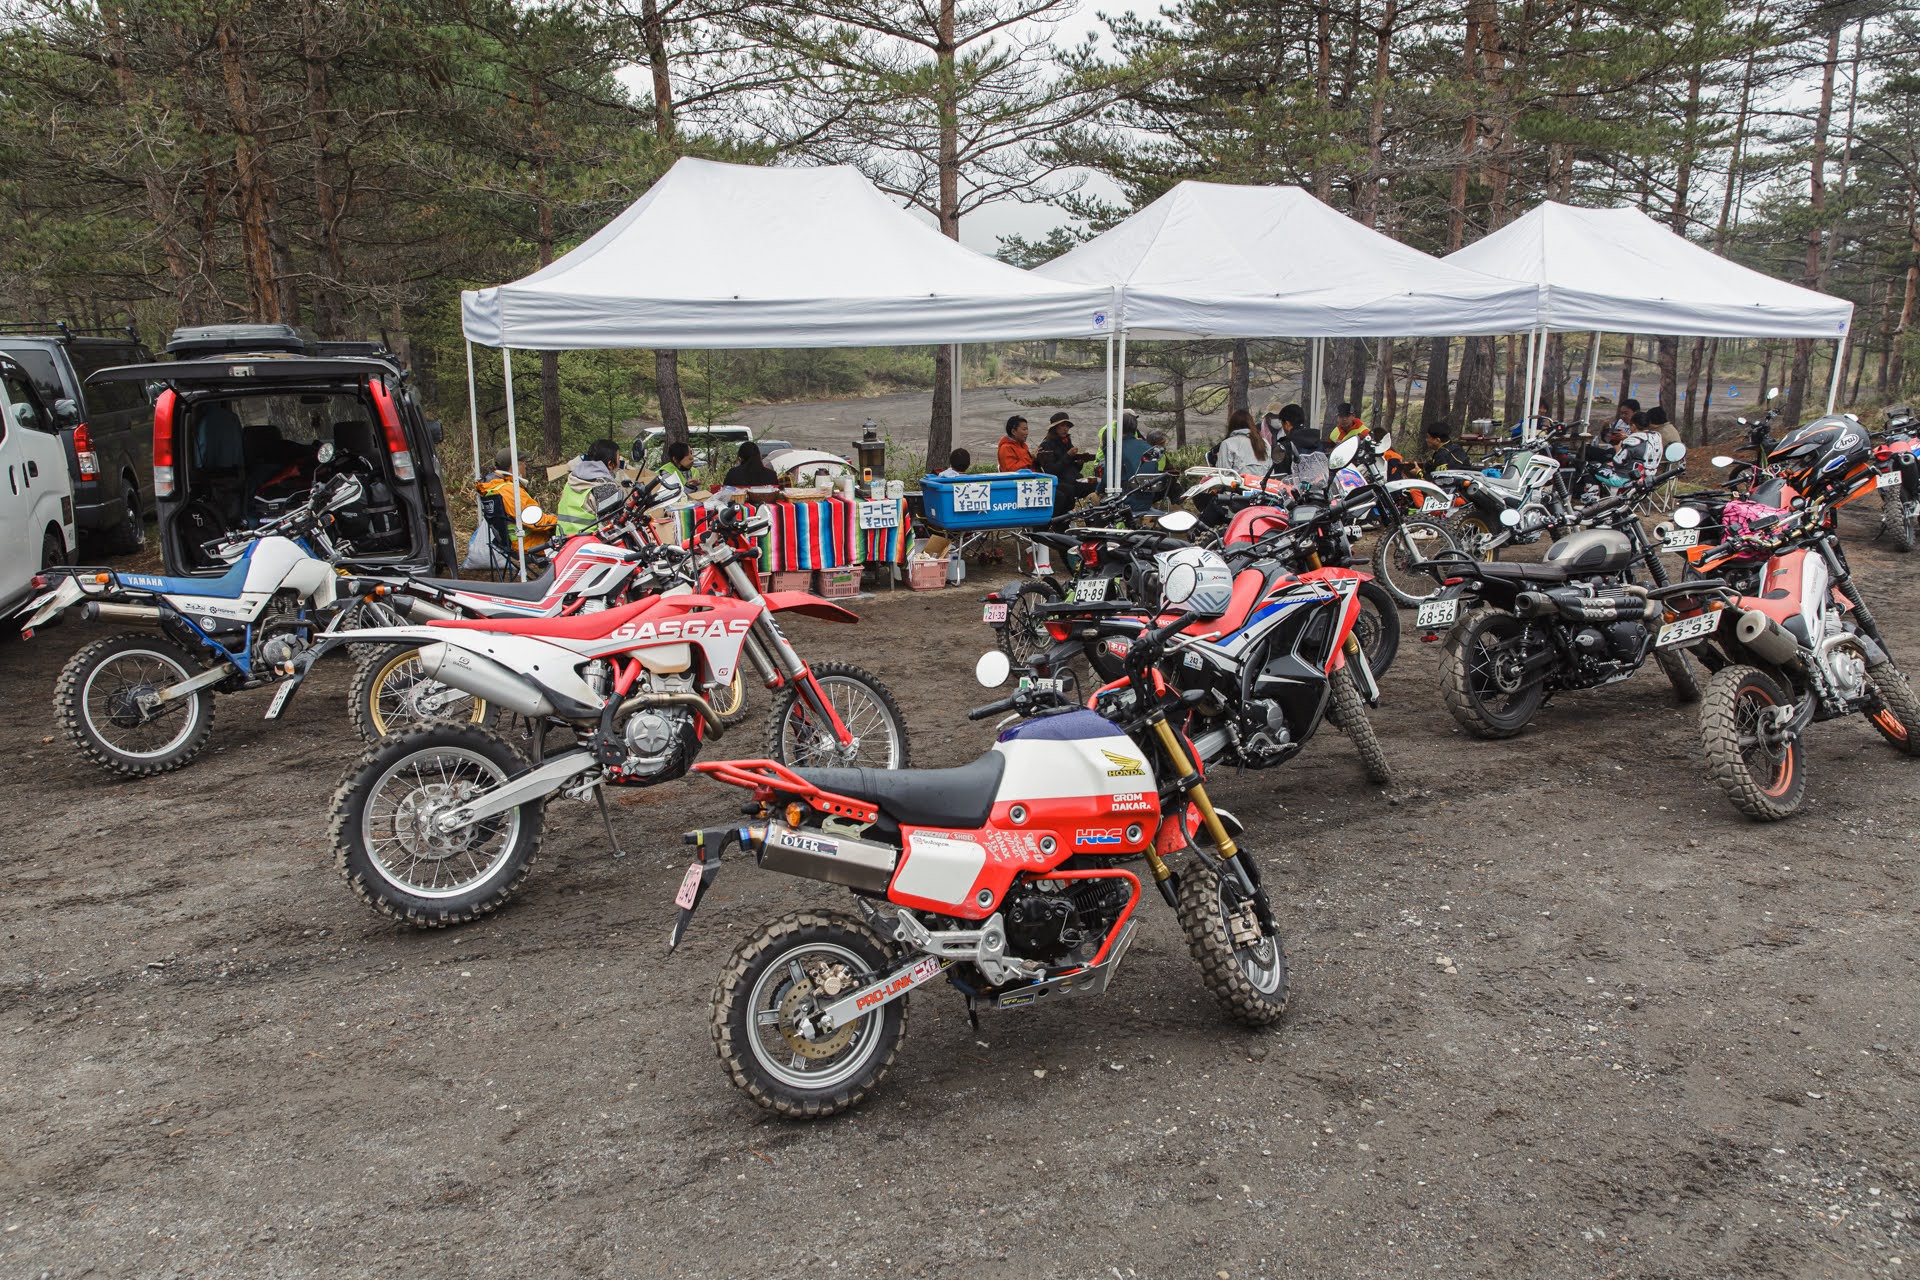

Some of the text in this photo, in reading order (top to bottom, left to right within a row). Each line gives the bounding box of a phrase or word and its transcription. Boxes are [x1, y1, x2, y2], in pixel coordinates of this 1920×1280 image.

[1839, 435, 1857, 447] Arai
[954, 484, 988, 499] ジュース
[1021, 481, 1049, 495] お茶
[959, 500, 988, 511] ¥200
[992, 502, 1025, 512] SAPPO
[1024, 496, 1051, 507] ¥150
[863, 503, 896, 516] コーヒー
[866, 517, 896, 528] ¥200
[1668, 534, 1696, 546] 5-79
[127, 576, 163, 587] YAMAHA
[1076, 588, 1104, 601] 83-89
[1418, 608, 1454, 625] 68-56
[611, 618, 750, 640] GASGAS
[1659, 619, 1715, 643] 63-93
[1107, 769, 1145, 777] HONDA
[1113, 793, 1142, 802] GROM
[953, 832, 974, 841] SHOEI
[1075, 828, 1122, 845] HRC
[783, 835, 820, 852] OVER
[994, 830, 1011, 859] TANAX
[856, 972, 915, 1011] PRO-LINK
